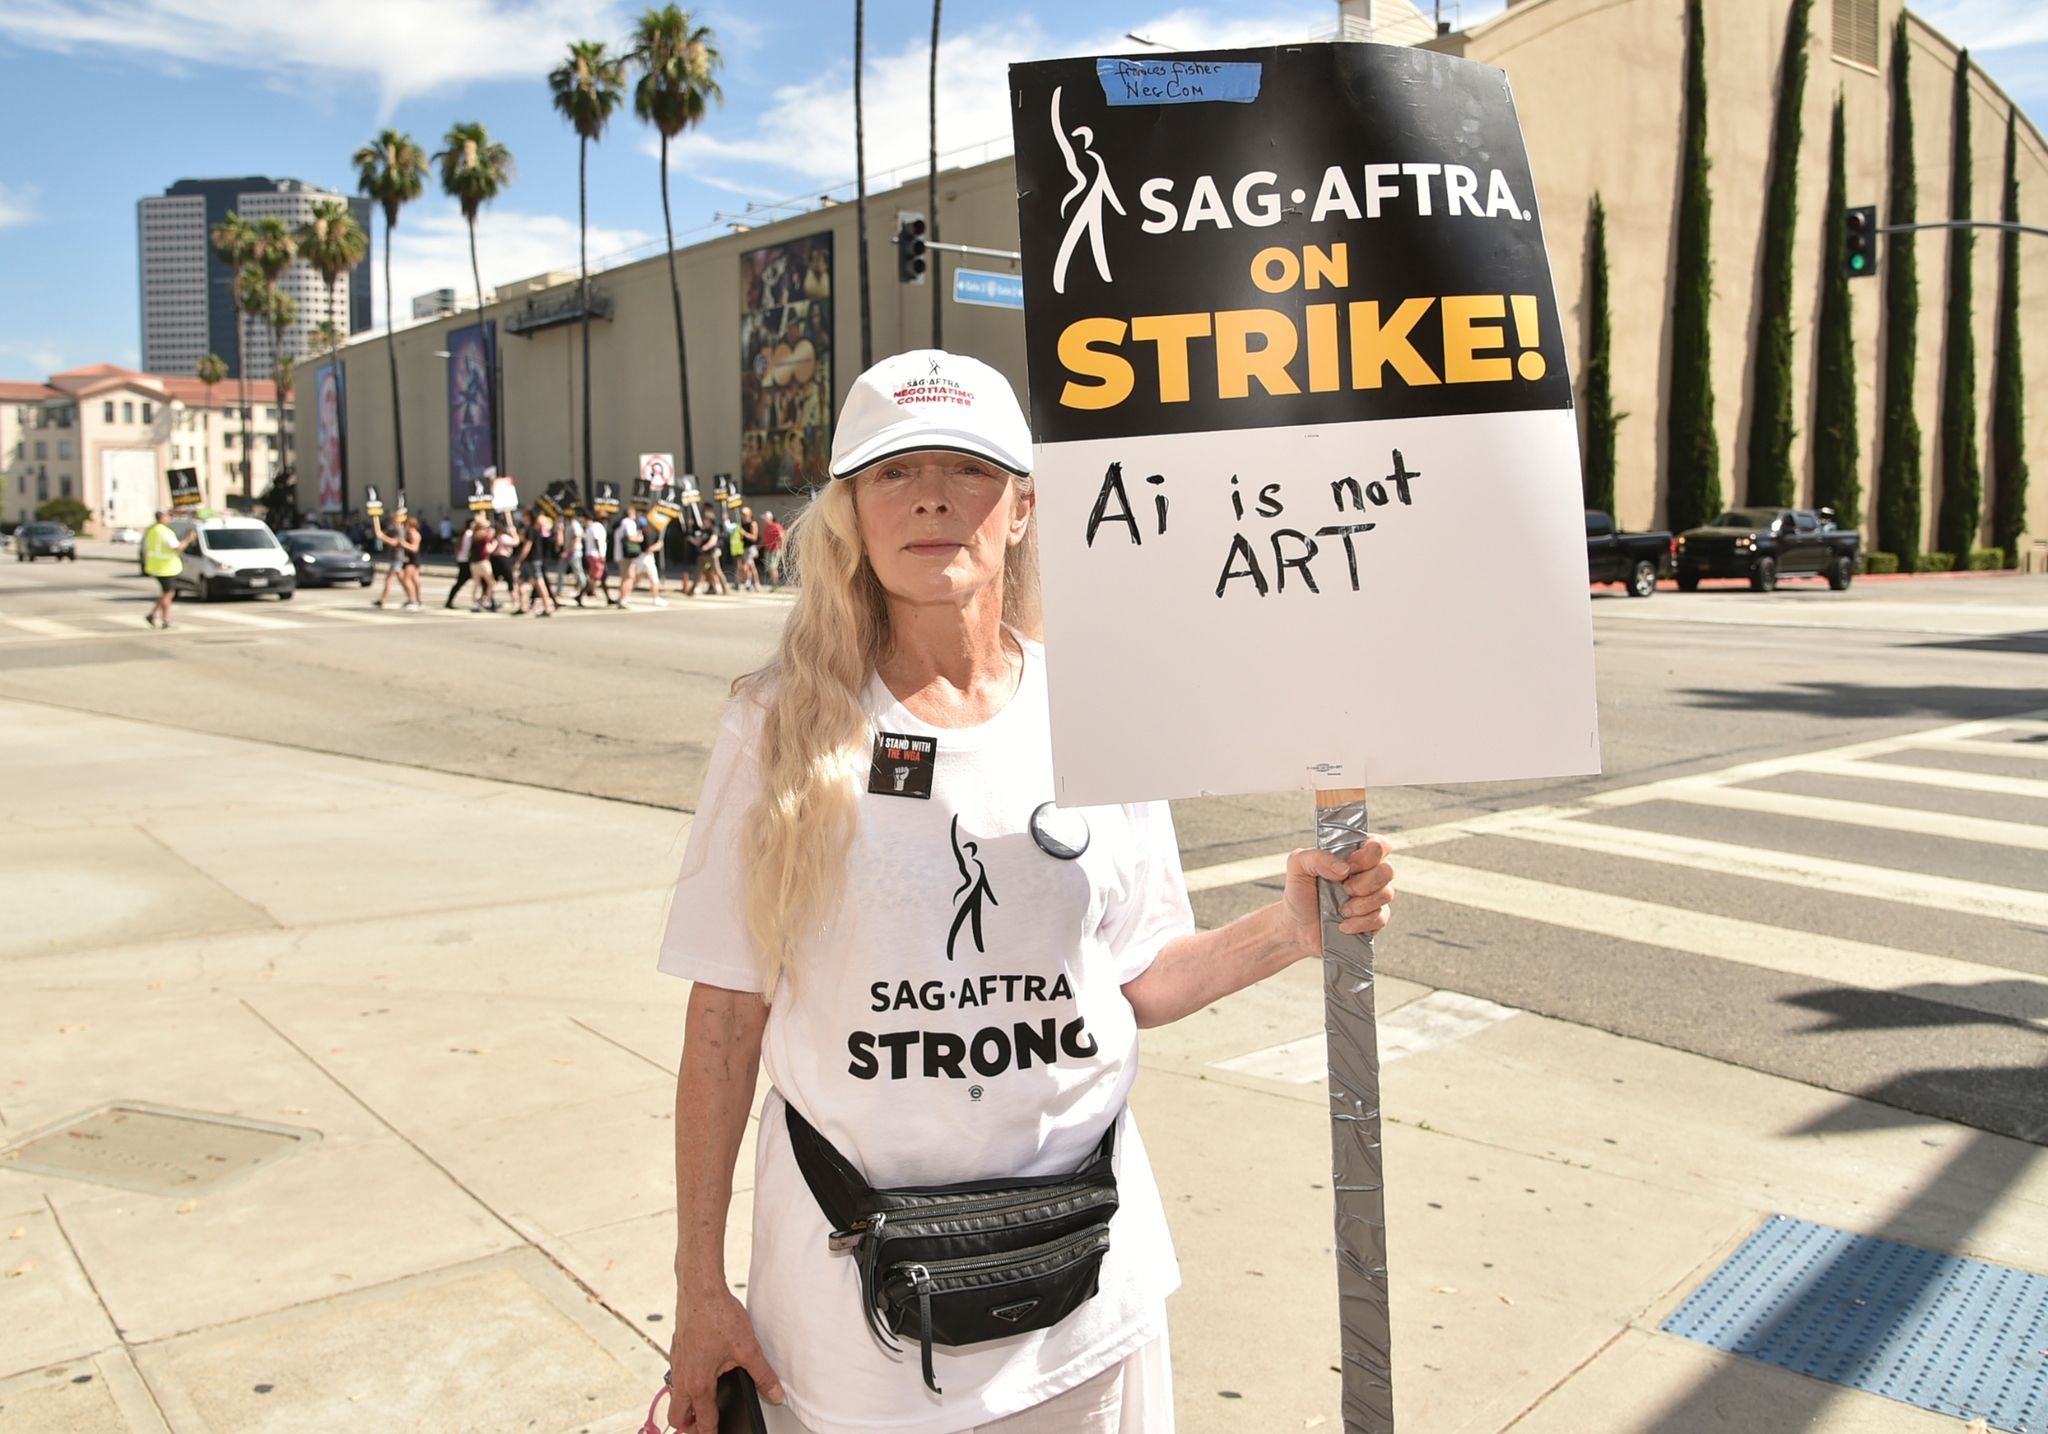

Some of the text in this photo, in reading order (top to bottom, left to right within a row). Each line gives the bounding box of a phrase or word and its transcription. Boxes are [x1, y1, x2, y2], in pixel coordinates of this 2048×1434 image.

[1250, 243, 1349, 293] ON
[1057, 294, 1546, 410] STRIKE!
[893, 386, 975, 399] NEGOTIATING
[897, 395, 971, 406] COMMITTEE
[1086, 448, 1421, 548] Ai is not
[1215, 522, 1376, 598] ART
[885, 737, 910, 750] STAND
[911, 740, 931, 753] WITH
[888, 748, 921, 762] THE WGA
[847, 1016, 1099, 1080] STRONG
